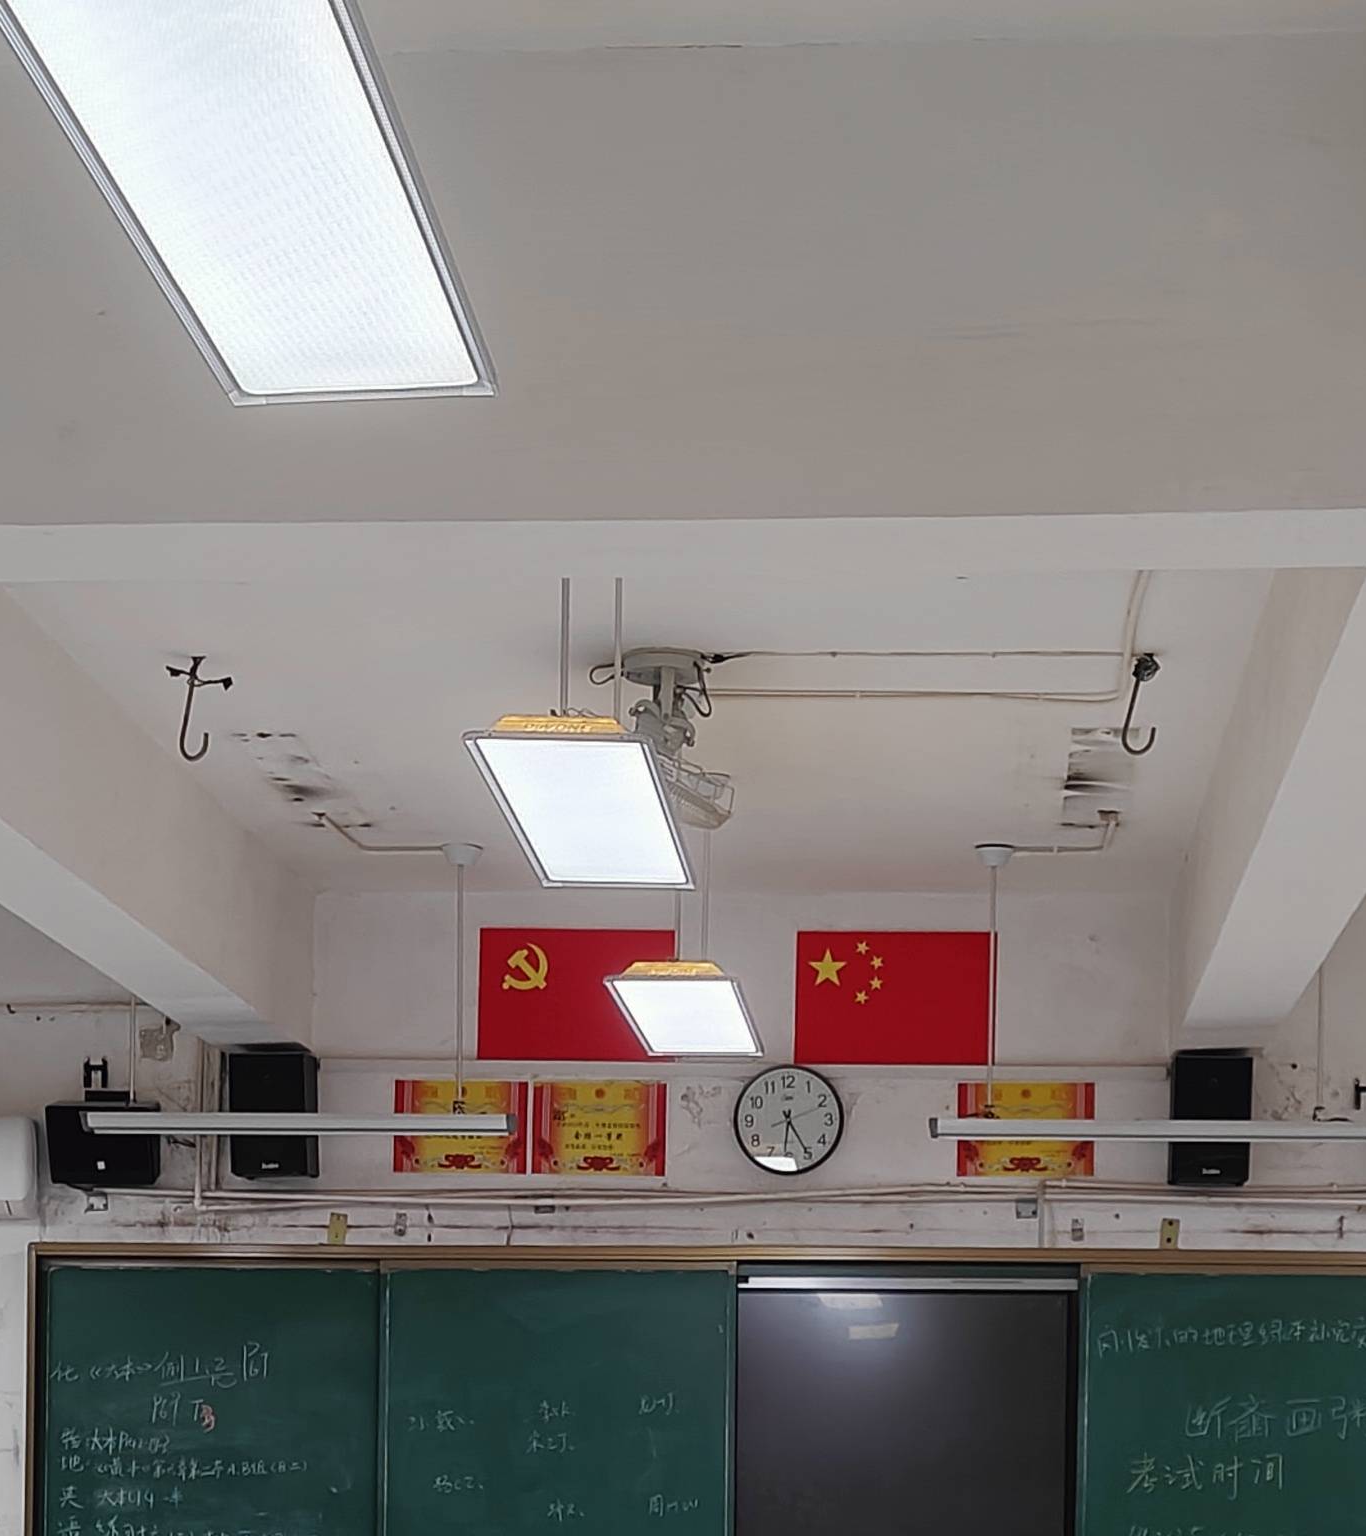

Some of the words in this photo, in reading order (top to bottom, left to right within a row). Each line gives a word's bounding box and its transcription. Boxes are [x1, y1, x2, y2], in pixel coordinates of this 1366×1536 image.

[764, 1080, 775, 1094] 11
[781, 1075, 795, 1089] 12
[806, 1080, 811, 1094] 1
[750, 1096, 763, 1109] 10
[818, 1094, 827, 1108] 2
[744, 1115, 754, 1128] 9
[824, 1112, 834, 1126] 3
[751, 1134, 760, 1147] 8
[817, 1133, 827, 1146] 4
[767, 1146, 775, 1157] 7
[804, 1147, 813, 1160] 5
[1127, 1453, 1284, 1500] 考试时间
